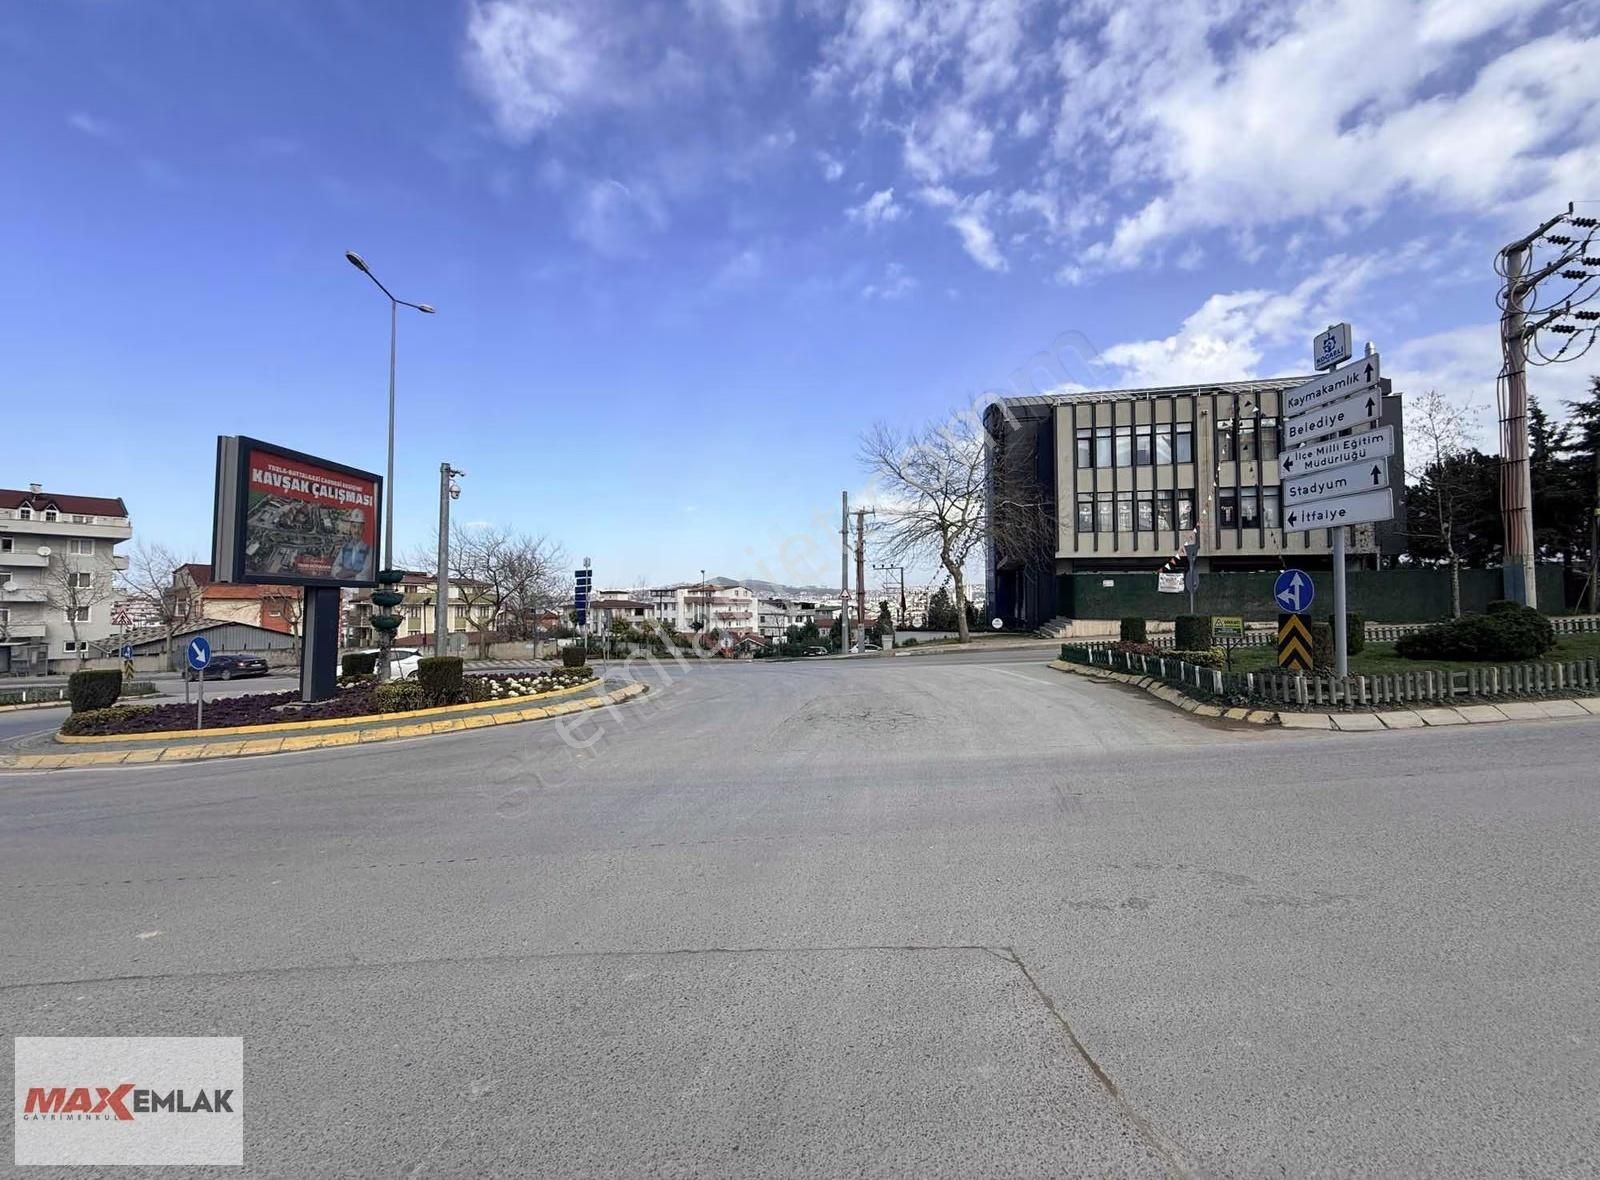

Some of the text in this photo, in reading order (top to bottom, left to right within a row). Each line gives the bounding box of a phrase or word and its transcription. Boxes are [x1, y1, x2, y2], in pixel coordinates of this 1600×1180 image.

[1287, 371, 1360, 408] Kaymakamlık
[1289, 411, 1346, 438] Belediye
[1295, 433, 1384, 461] İlçe Milli Eğitim
[1304, 448, 1366, 471] Müdürlüğü
[252, 468, 310, 494] KAVŞAK
[311, 483, 373, 507] ÇALIŞMASI
[1289, 475, 1348, 498] Stadyum
[1301, 505, 1347, 525] İtfaiye
